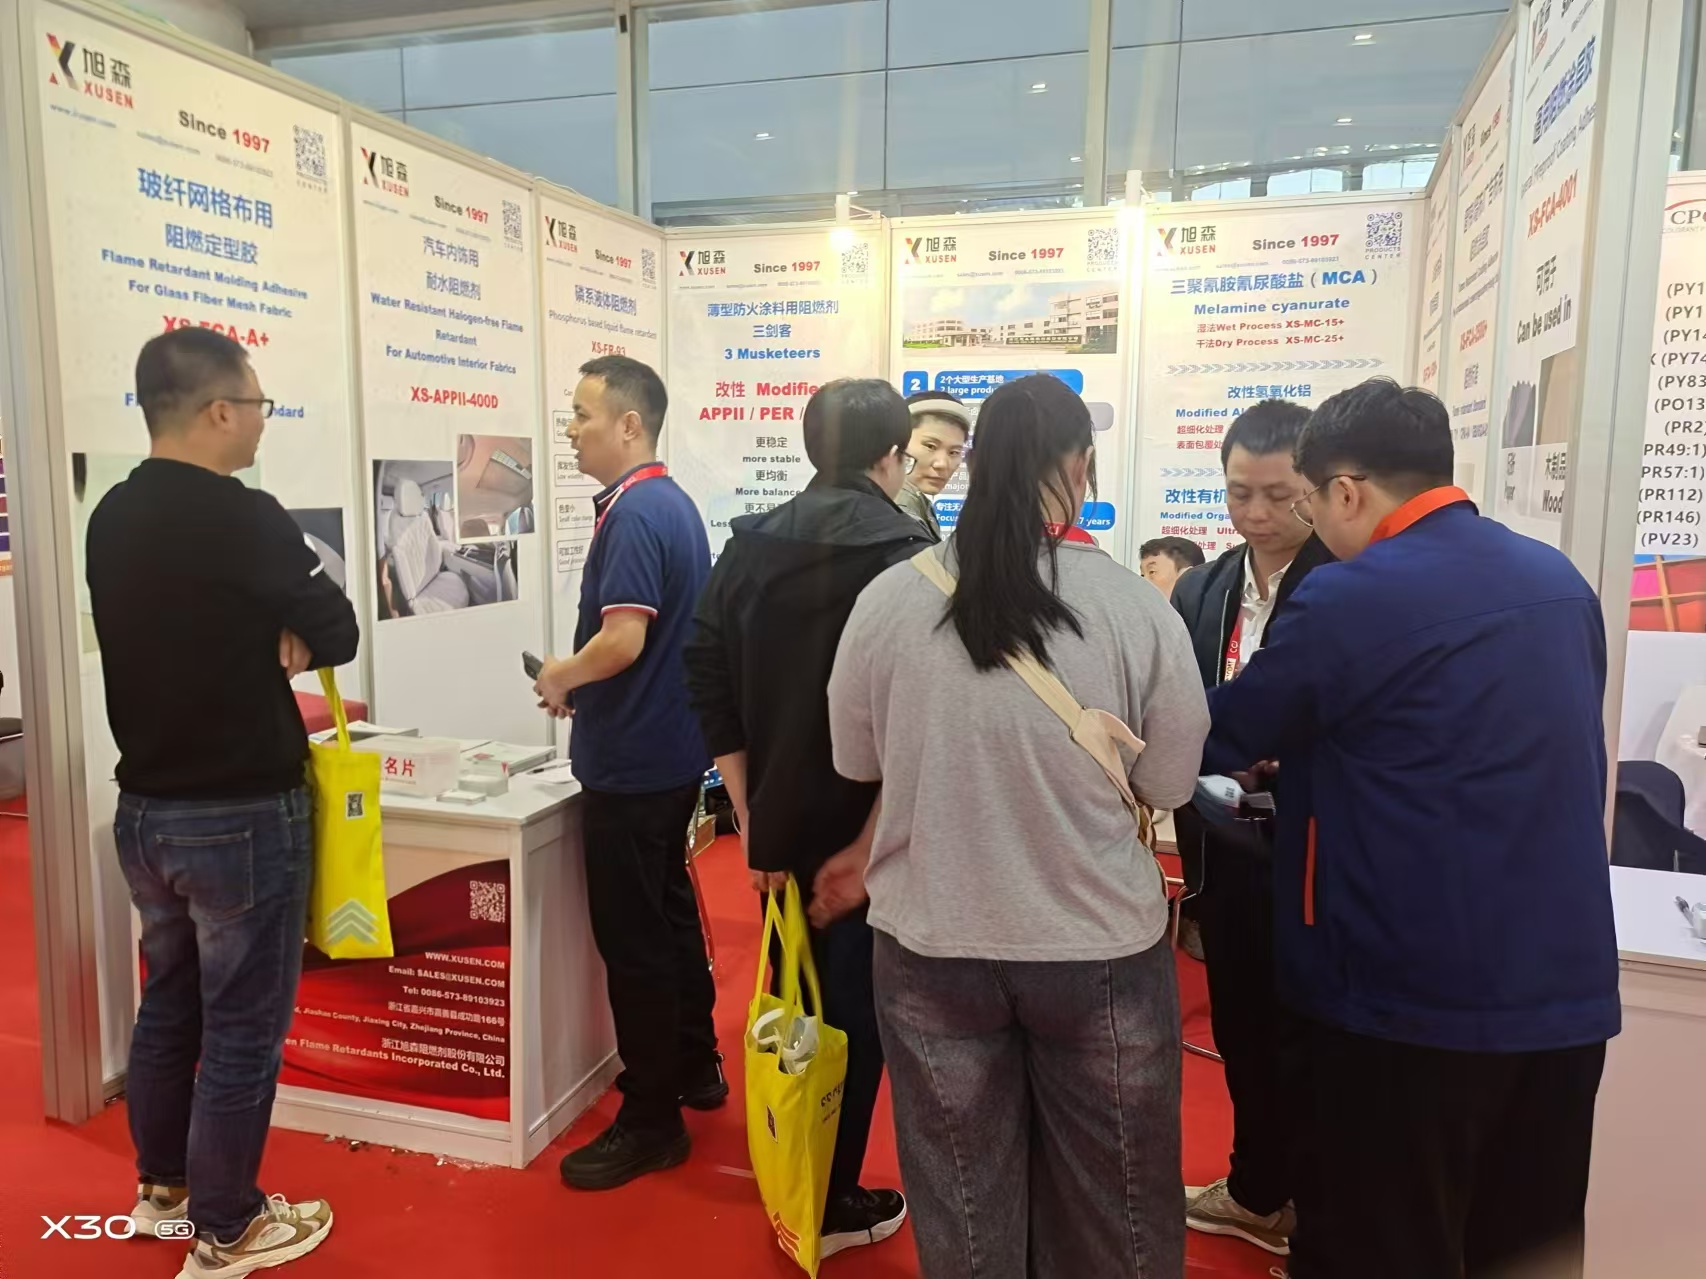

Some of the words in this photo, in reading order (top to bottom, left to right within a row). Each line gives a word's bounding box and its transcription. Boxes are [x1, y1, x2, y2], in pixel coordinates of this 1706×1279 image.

[82, 48, 131, 88] 旭森
[84, 81, 134, 109] XUSEN
[179, 110, 226, 140] Since
[233, 129, 270, 153] 1997
[380, 154, 408, 183] 旭森
[382, 179, 409, 198] XUSEN
[137, 168, 273, 228] 玻纤网格布用
[434, 195, 463, 216] Since
[465, 207, 488, 225] 1997
[1671, 209, 1706, 225] CP
[1181, 225, 1216, 243] 旭森
[165, 224, 258, 264] 阻燃定型胶
[559, 240, 578, 253] XUSEN
[926, 236, 957, 252] 旭森
[1180, 244, 1216, 255] XUSEN
[1252, 238, 1296, 251] Since
[1301, 234, 1340, 248] 1997
[423, 235, 480, 268] 汽车内饰用
[595, 249, 614, 264] Since
[616, 256, 632, 269] 1997
[698, 250, 726, 265] 旭森
[925, 254, 957, 264] XUSEN
[988, 249, 1026, 262] Since
[1030, 247, 1064, 260] 1997
[101, 249, 145, 269] Flame
[149, 258, 211, 281] Retardant
[214, 271, 258, 292] Molding
[262, 281, 308, 300] Adhesive
[697, 267, 726, 276] XUSEN
[753, 263, 787, 274] Since
[791, 261, 820, 272] 1997
[426, 271, 481, 301] 耐水阻燃剂
[1667, 282, 1704, 299] (PY1
[129, 280, 149, 295] For
[154, 284, 189, 301] Glass
[193, 291, 223, 307] Fiber
[227, 296, 256, 312] Mesh
[260, 302, 293, 318] Fabric
[1194, 302, 1266, 315] Melamine
[1271, 298, 1350, 314] cyanurate
[370, 292, 401, 309] Water
[404, 299, 446, 318] Resistant
[449, 307, 500, 330] Halogen-free
[501, 319, 524, 333] Flame
[707, 299, 839, 318] 薄型防火涂料用阻燃剂
[1665, 305, 1702, 322] (PY1
[1240, 321, 1282, 331] Process
[1286, 318, 1345, 329] XS-MC-15+
[1517, 320, 1531, 344] Can
[1532, 312, 1543, 338] be
[1544, 296, 1562, 332] used
[1563, 293, 1571, 323] in
[435, 329, 477, 346] Retardant
[752, 324, 792, 338] 三剑客
[1236, 337, 1279, 347] Process
[1286, 334, 1345, 345] XS-MC-25+
[386, 345, 402, 358] For
[405, 348, 456, 367] Automotive
[458, 356, 488, 371] Interior
[490, 360, 517, 375] Fabrics
[724, 349, 733, 360] 3
[737, 348, 821, 360] Musketeers
[1661, 352, 1706, 368] (PY74
[910, 378, 921, 391] 2
[940, 375, 1005, 385] 2个大型生产基地
[1658, 375, 1706, 391] (PY83
[411, 386, 499, 409] XS-APPII-400D
[715, 382, 746, 398] 改性
[756, 382, 821, 397] Modifie
[947, 386, 969, 396] large
[970, 386, 995, 396] produ
[1228, 384, 1312, 399] 改性氢氧化铝
[271, 404, 305, 419] ndard
[699, 407, 744, 421] APPII
[760, 406, 794, 421] PER
[1176, 408, 1228, 418] Modified
[1232, 408, 1245, 418] Al
[1654, 398, 1705, 413] (PO13
[1177, 425, 1224, 435] 超细化处理
[755, 436, 788, 448] 更稳定
[1176, 440, 1223, 450] 表面包覆处
[742, 455, 767, 464] more
[770, 454, 801, 464] stable
[1643, 443, 1706, 459] PR49:1)
[755, 469, 788, 482] 更均衡
[1641, 466, 1705, 481] PR57:1)
[735, 487, 760, 496] More
[762, 487, 801, 497] balance
[1165, 488, 1227, 504] 改性有机
[1638, 488, 1703, 503] (PR112)
[1542, 489, 1565, 514] Wood
[1086, 518, 1111, 527] years
[1160, 511, 1203, 520] Modified
[1206, 512, 1230, 522] Orga
[1636, 511, 1701, 526] (PR146)
[1161, 526, 1207, 535] 超细化处理
[1217, 527, 1239, 535] Ultr
[1641, 533, 1698, 548] (PV23)
[384, 756, 416, 777] 名片
[425, 952, 505, 970] WWW.XUSEN.COM
[388, 965, 415, 977] Email:
[417, 969, 505, 988] SALES@XUSEN.COM
[403, 985, 419, 996] Tel:
[420, 988, 505, 1007] 0086-573-89103923
[304, 1008, 331, 1019] Jiashan
[332, 1011, 361, 1024] County,
[363, 1015, 390, 1028] Jiaxing
[391, 1019, 409, 1031] City,
[410, 1022, 443, 1036] Zhejiang
[445, 1027, 481, 1041] Province,
[482, 1032, 505, 1043] China
[285, 1038, 297, 1047] en
[300, 1038, 330, 1051] Flame
[332, 1043, 389, 1060] Retardants
[391, 1052, 458, 1071] Incorporated
[461, 1063, 482, 1076] Co.,
[483, 1066, 505, 1079] Ltd.
[381, 1038, 505, 1066] 浙江旭森阻燃剂股份有限公司
